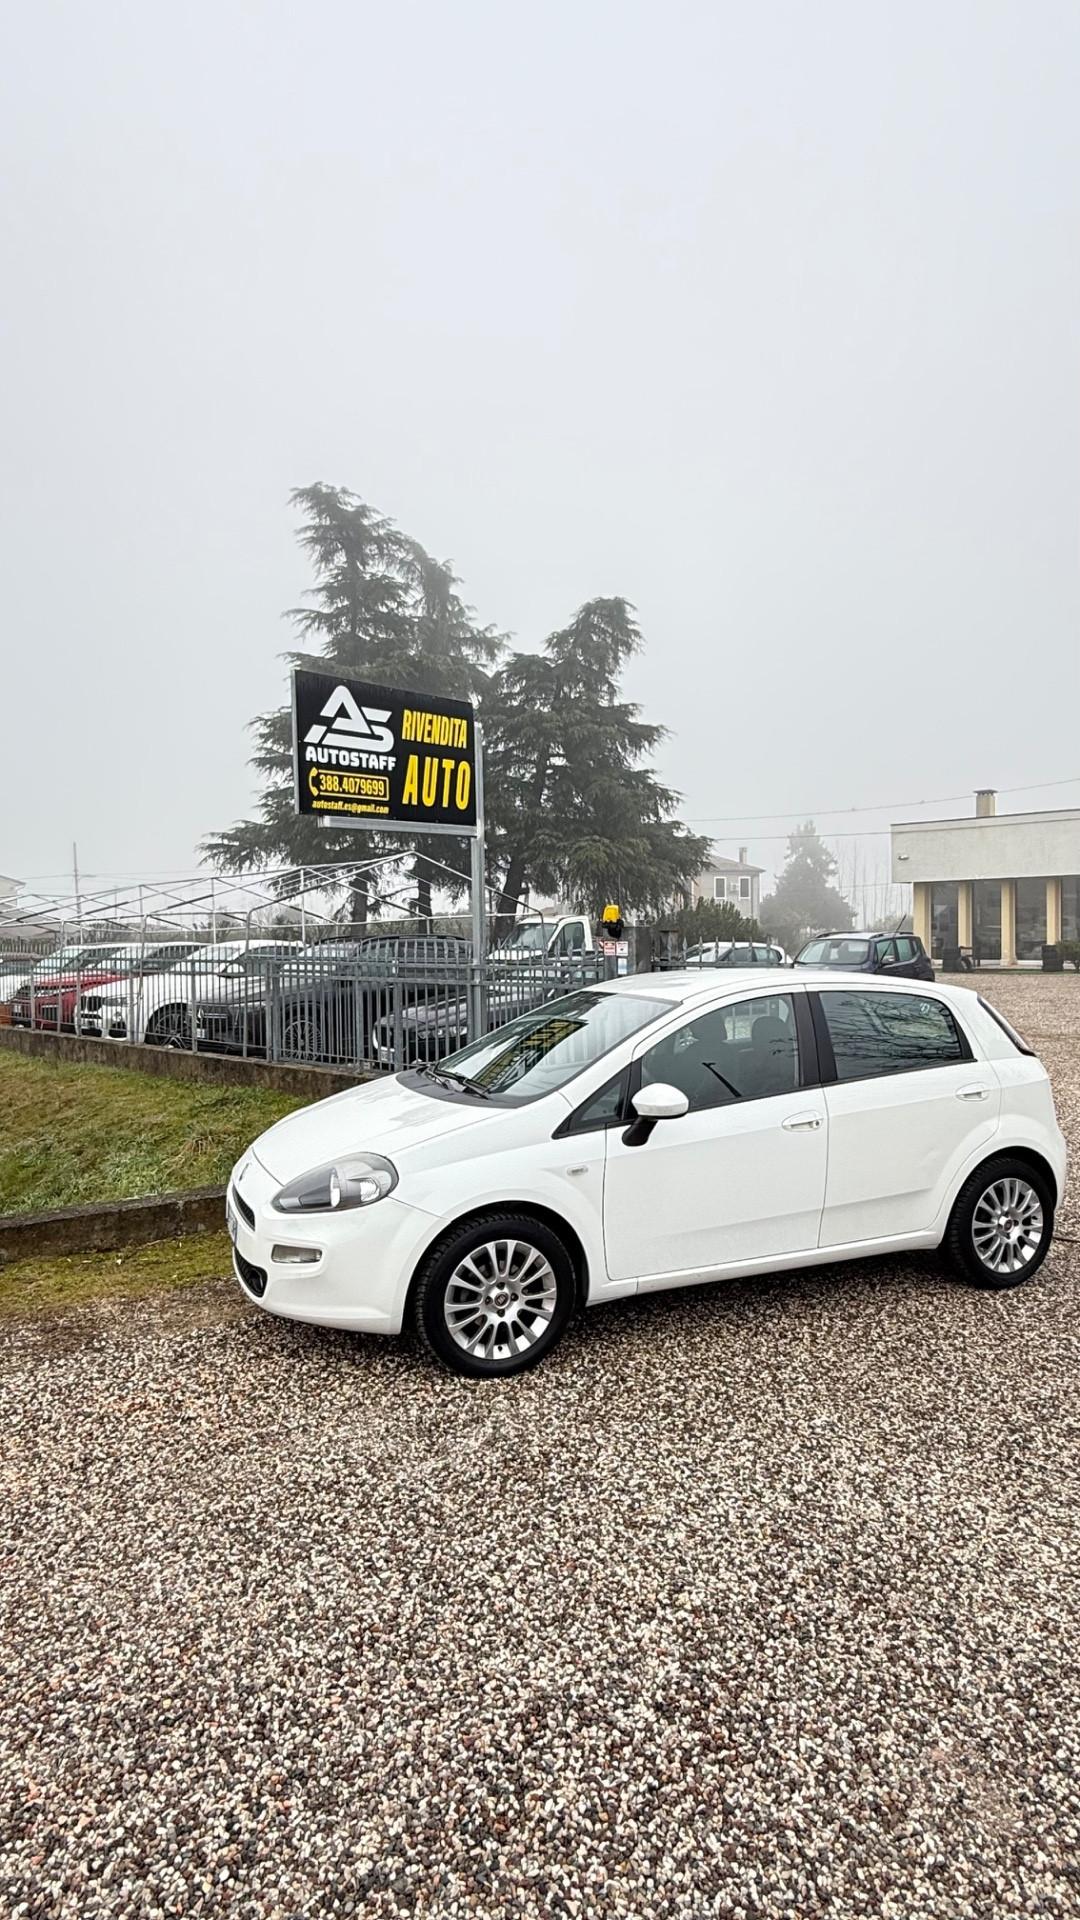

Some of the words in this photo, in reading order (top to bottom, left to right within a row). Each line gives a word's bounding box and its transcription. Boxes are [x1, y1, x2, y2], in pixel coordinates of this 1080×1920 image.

[402, 709, 467, 749] RIVENDITA
[305, 746, 397, 771] AUTOSTAFF
[319, 774, 385, 796] 388.4079699
[402, 754, 471, 810] AUTO
